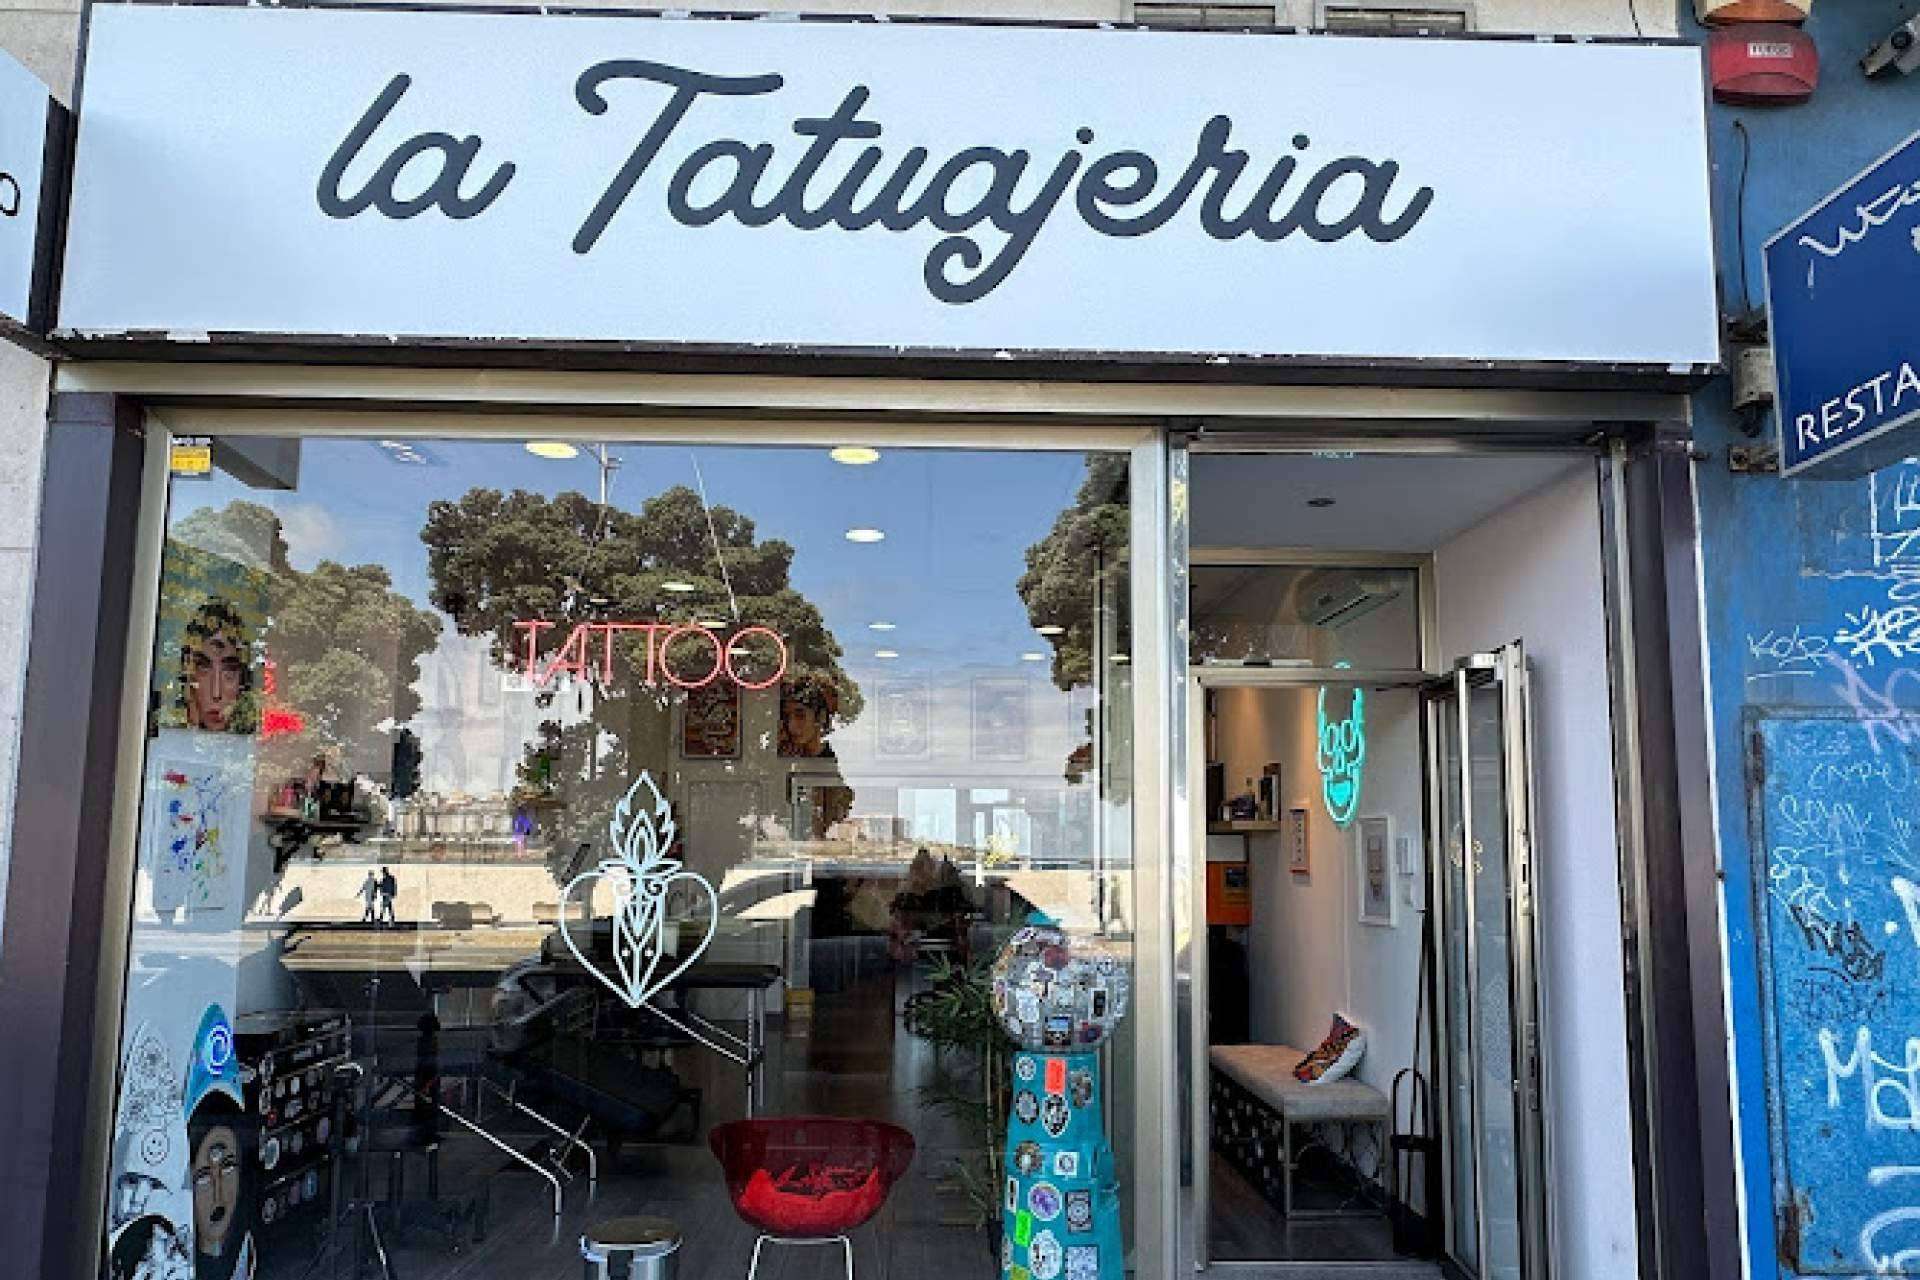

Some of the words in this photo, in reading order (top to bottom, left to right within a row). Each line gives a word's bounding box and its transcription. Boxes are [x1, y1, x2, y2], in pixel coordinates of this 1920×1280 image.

[316, 73, 516, 220] la
[571, 59, 1435, 305] Tatuajeria
[512, 619, 787, 690] TATTOO
